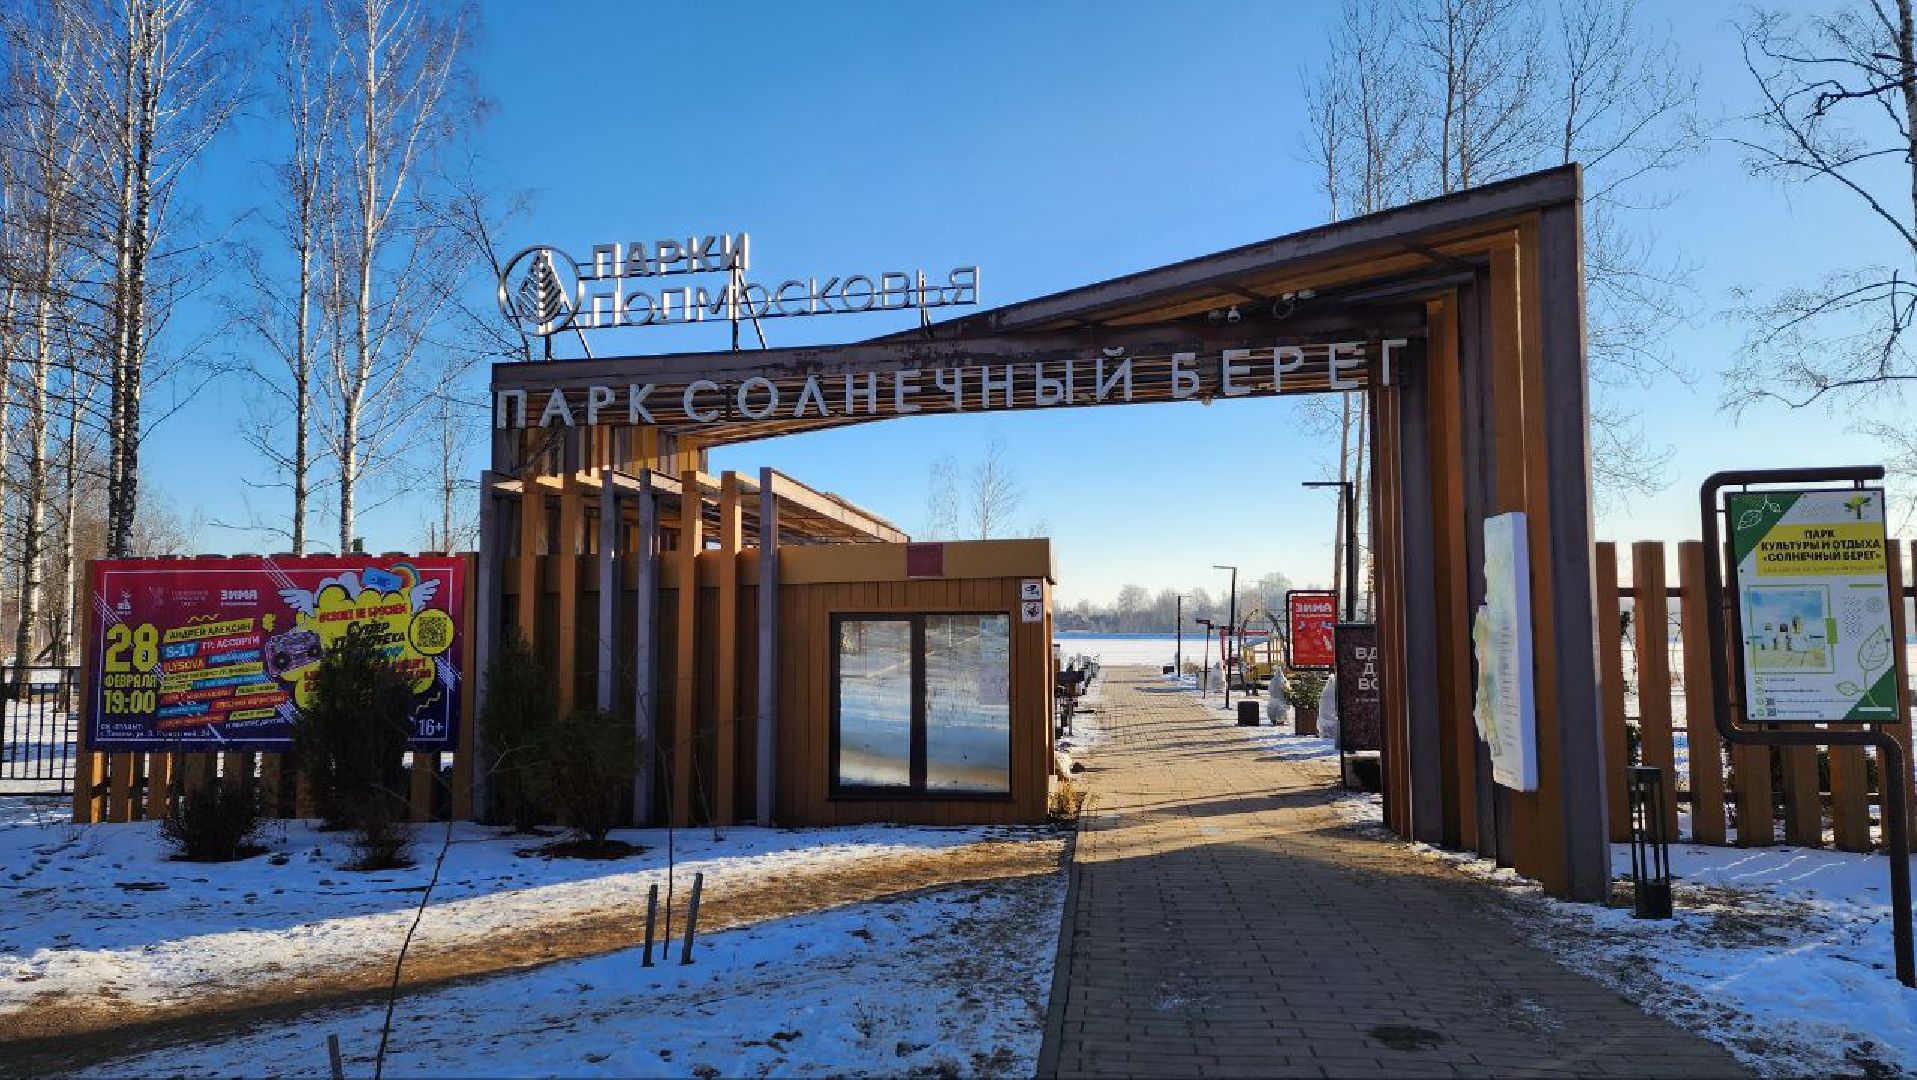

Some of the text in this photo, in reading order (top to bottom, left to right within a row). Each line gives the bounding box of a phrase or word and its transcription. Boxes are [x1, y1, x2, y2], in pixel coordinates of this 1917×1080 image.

[591, 232, 749, 279] ПАРКИ
[586, 265, 980, 327] ПОДМОСКОВЬЯ
[497, 339, 1407, 430] ПАРК СОЛНЕЧНЫЙ БЕРЕГ
[1804, 529, 1835, 539] ПАРК
[1761, 538, 1882, 551] КУЛЬТУРЫ И ОТДЫХА
[1763, 550, 1882, 562] «СОЛНЕЧНЫЙ БЕРЕГ»
[220, 589, 257, 601] ЗИМА
[1296, 603, 1332, 613] ЗИМА
[106, 623, 158, 672] 28
[165, 643, 196, 658] S-17
[105, 674, 157, 688] ФЕВРАЛЯ
[104, 690, 156, 714] 19:00
[418, 719, 443, 737] 16+
